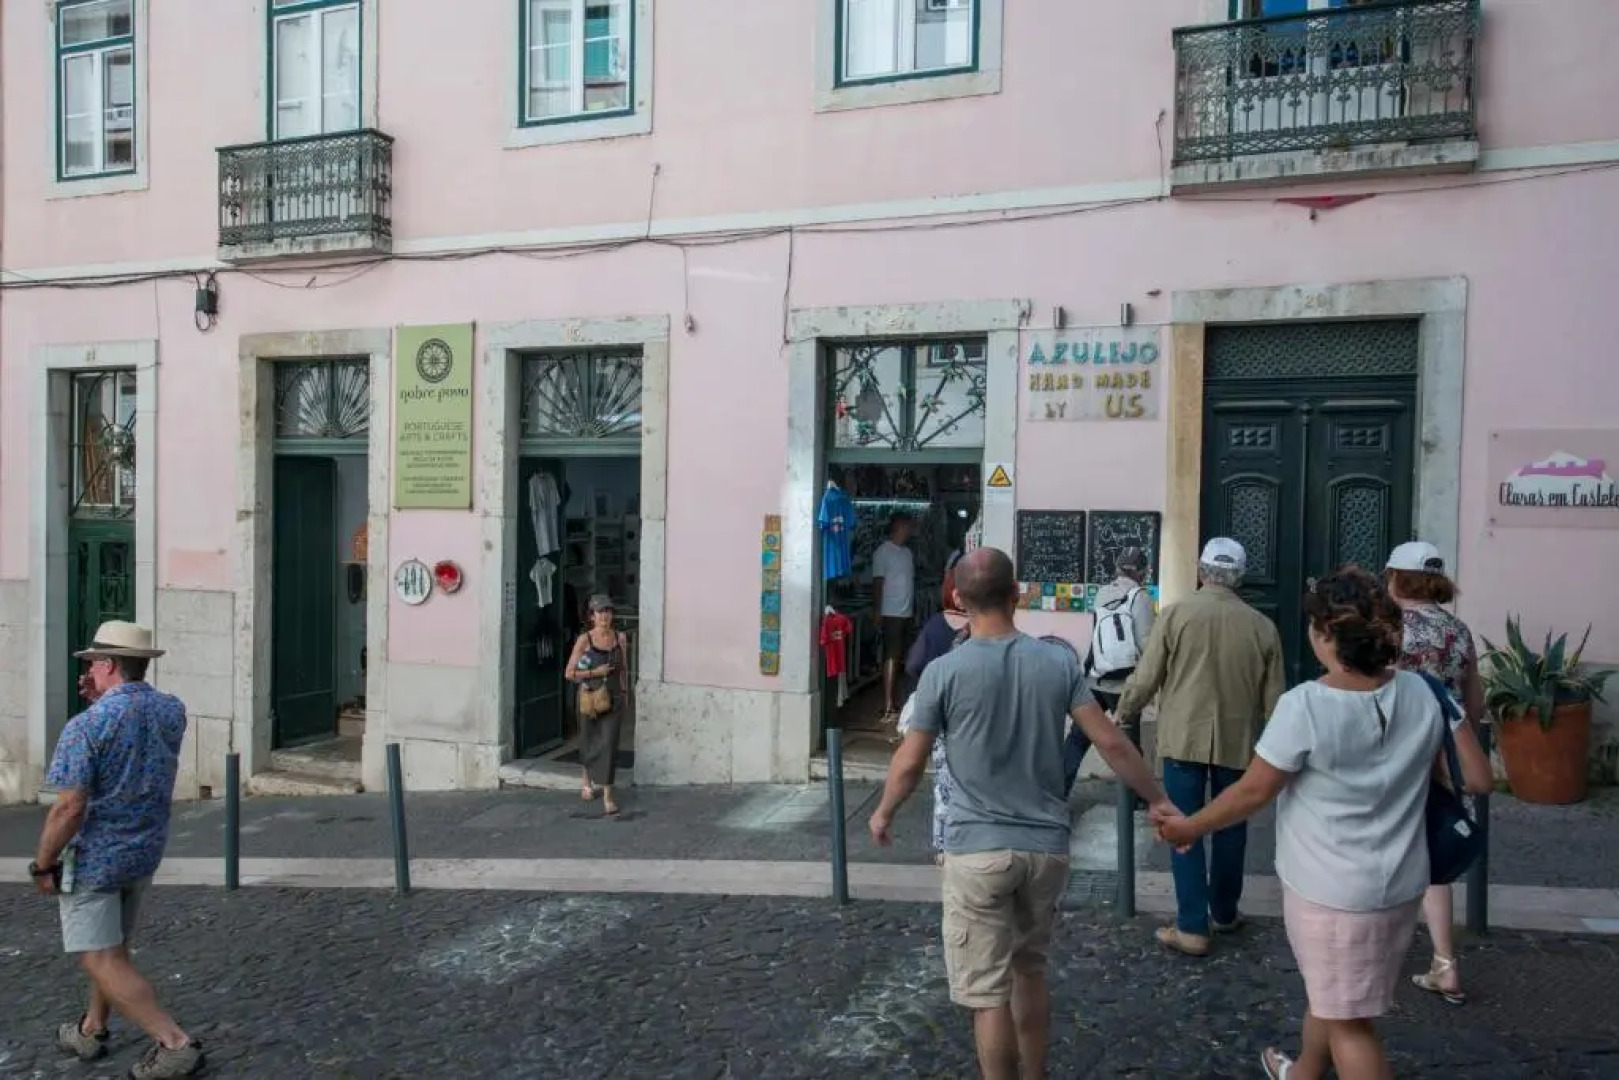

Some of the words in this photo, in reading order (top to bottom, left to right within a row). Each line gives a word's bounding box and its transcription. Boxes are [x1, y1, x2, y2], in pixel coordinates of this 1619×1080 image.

[1028, 342, 1158, 364] AZULEJO
[1029, 372, 1084, 392] HAND
[1095, 369, 1152, 389] MADE
[1106, 393, 1146, 418] US
